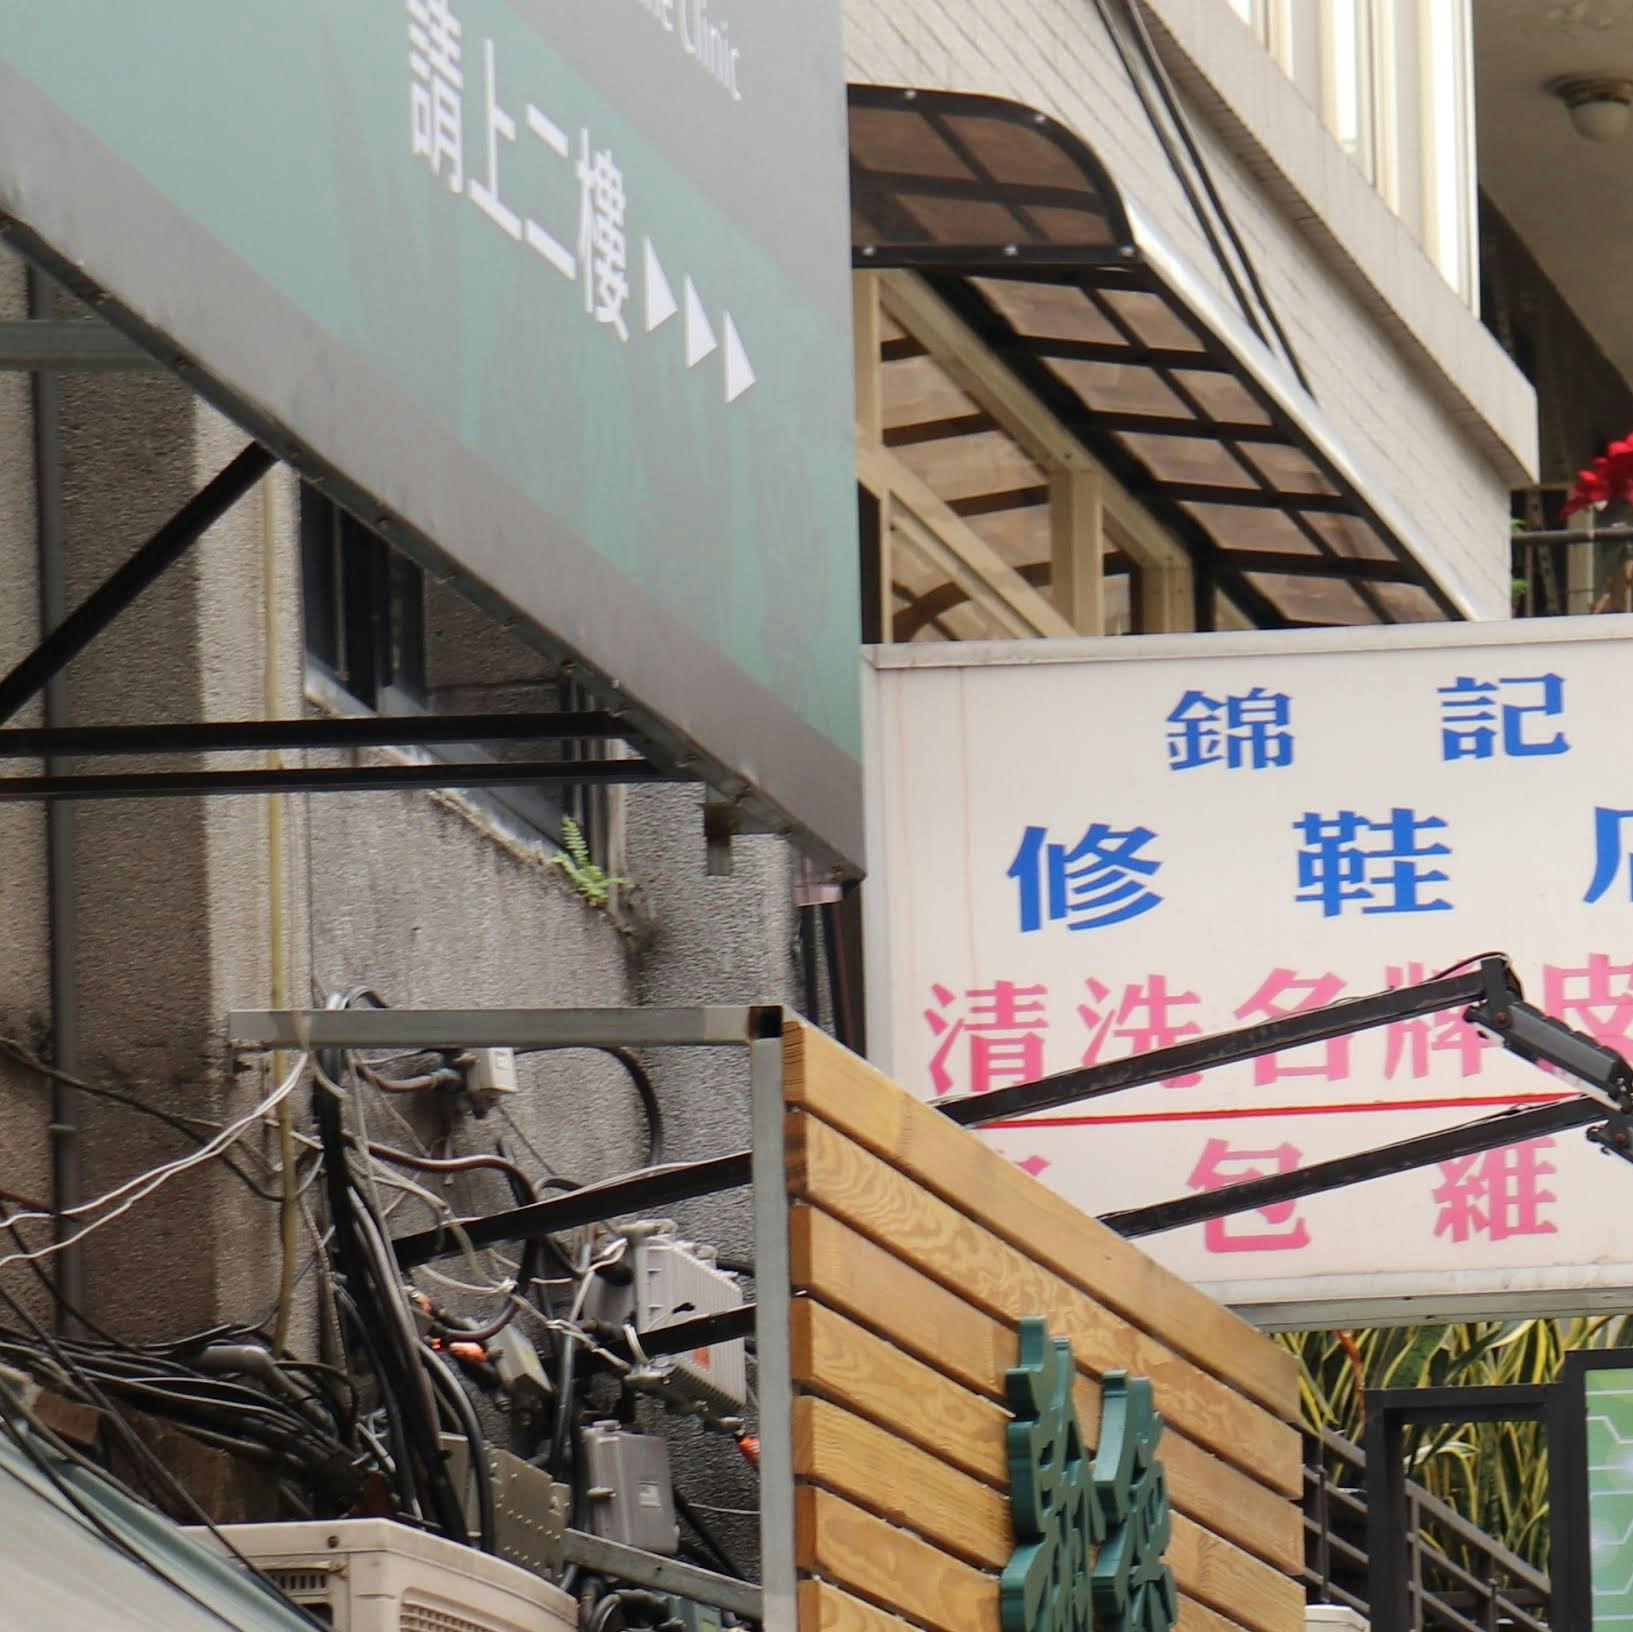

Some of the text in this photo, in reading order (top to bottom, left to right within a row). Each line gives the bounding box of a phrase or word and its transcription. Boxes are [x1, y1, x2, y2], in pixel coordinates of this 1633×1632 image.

[408, 0, 630, 341] 請上二樓
[1165, 673, 1571, 770] 錦記
